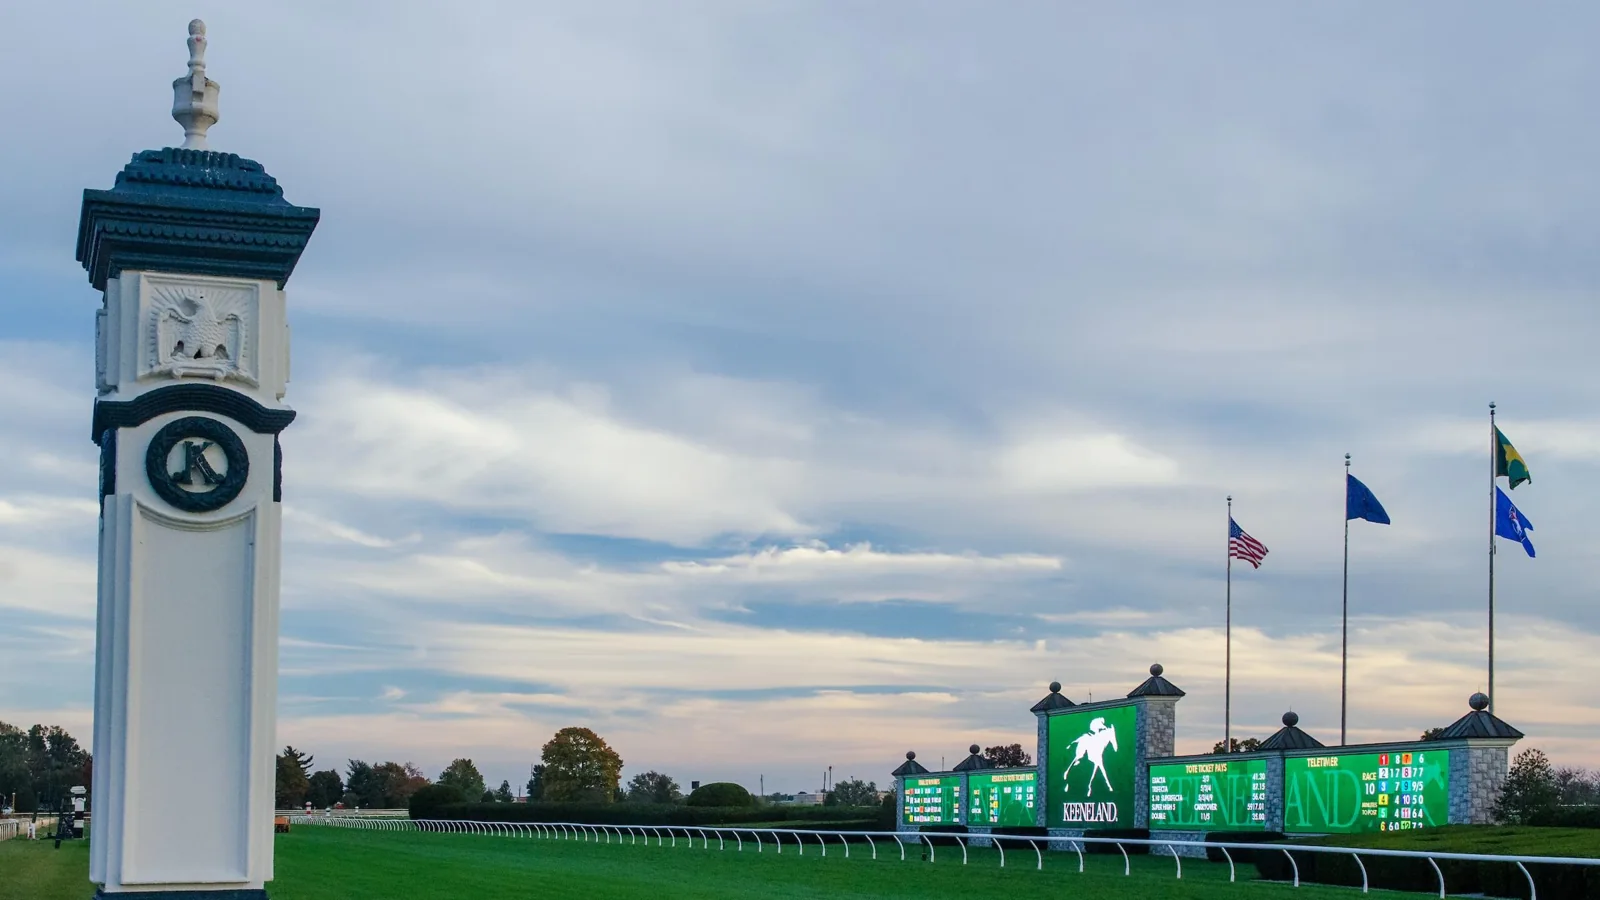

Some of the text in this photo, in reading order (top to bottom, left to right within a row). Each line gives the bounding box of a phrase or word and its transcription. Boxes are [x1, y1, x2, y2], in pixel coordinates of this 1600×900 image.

[173, 441, 226, 485] K
[1307, 757, 1338, 767] TELETIMER
[1395, 754, 1401, 765] 8
[1419, 753, 1425, 764] 6
[1186, 764, 1226, 774] TOTE TICKET PAYS
[1362, 772, 1377, 781] RACE
[1365, 782, 1376, 795] 10
[1395, 781, 1401, 792] 7
[1412, 781, 1424, 792] 9/5
[1394, 795, 1400, 805] 4
[1402, 794, 1411, 805] 10
[1394, 808, 1400, 819] 4
[1380, 821, 1386, 831] 6
